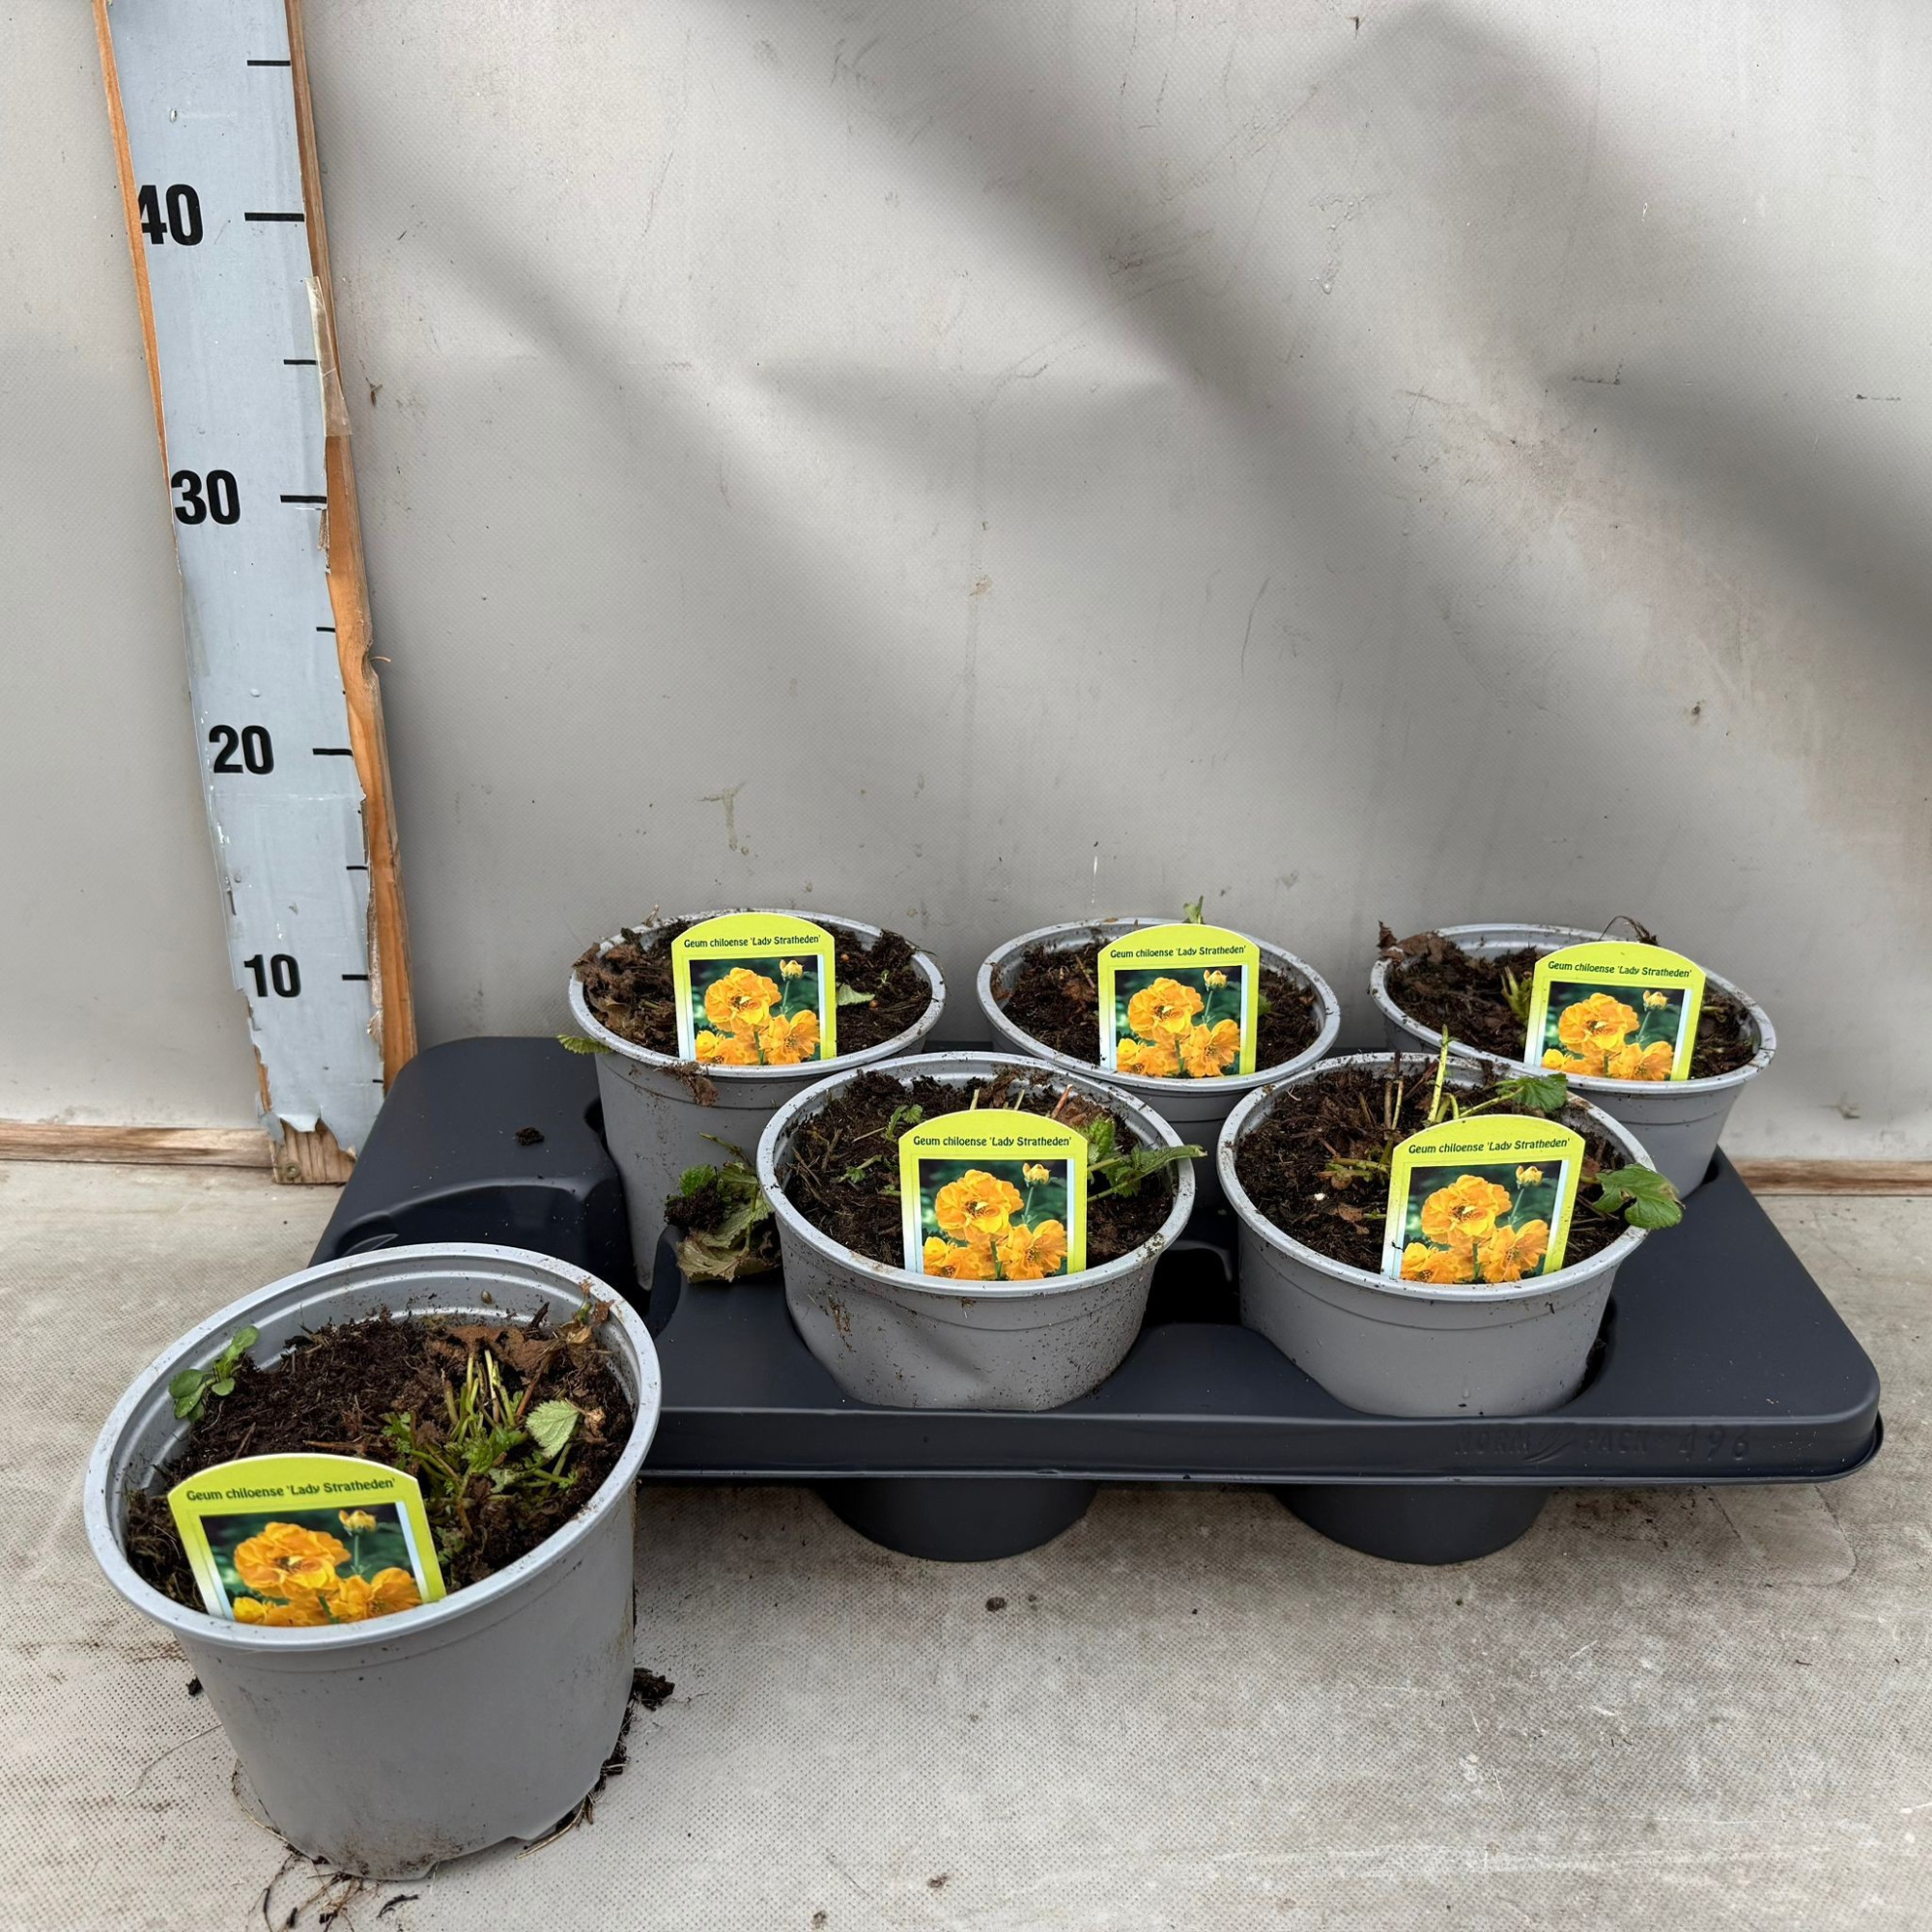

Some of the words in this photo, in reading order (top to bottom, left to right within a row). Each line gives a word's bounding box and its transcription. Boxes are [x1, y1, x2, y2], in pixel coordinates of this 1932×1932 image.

[137, 184, 203, 246] 40
[171, 469, 241, 526] 30
[209, 724, 274, 775] 20
[684, 939, 708, 949] Geum
[710, 937, 749, 947] chiloense
[1110, 949, 1134, 958] Geum
[1135, 947, 1174, 957] chiloense
[1548, 961, 1573, 971] Geum
[1575, 963, 1615, 974] chiloense
[243, 953, 301, 998] 10
[913, 1135, 941, 1146] Geum
[943, 1136, 987, 1147] chiloense
[1408, 1144, 1436, 1154] Geum
[1438, 1142, 1484, 1153] chiloense
[1678, 1425, 1750, 1461] 496
[185, 1490, 223, 1502] Geum
[226, 1487, 284, 1499] chiloense
